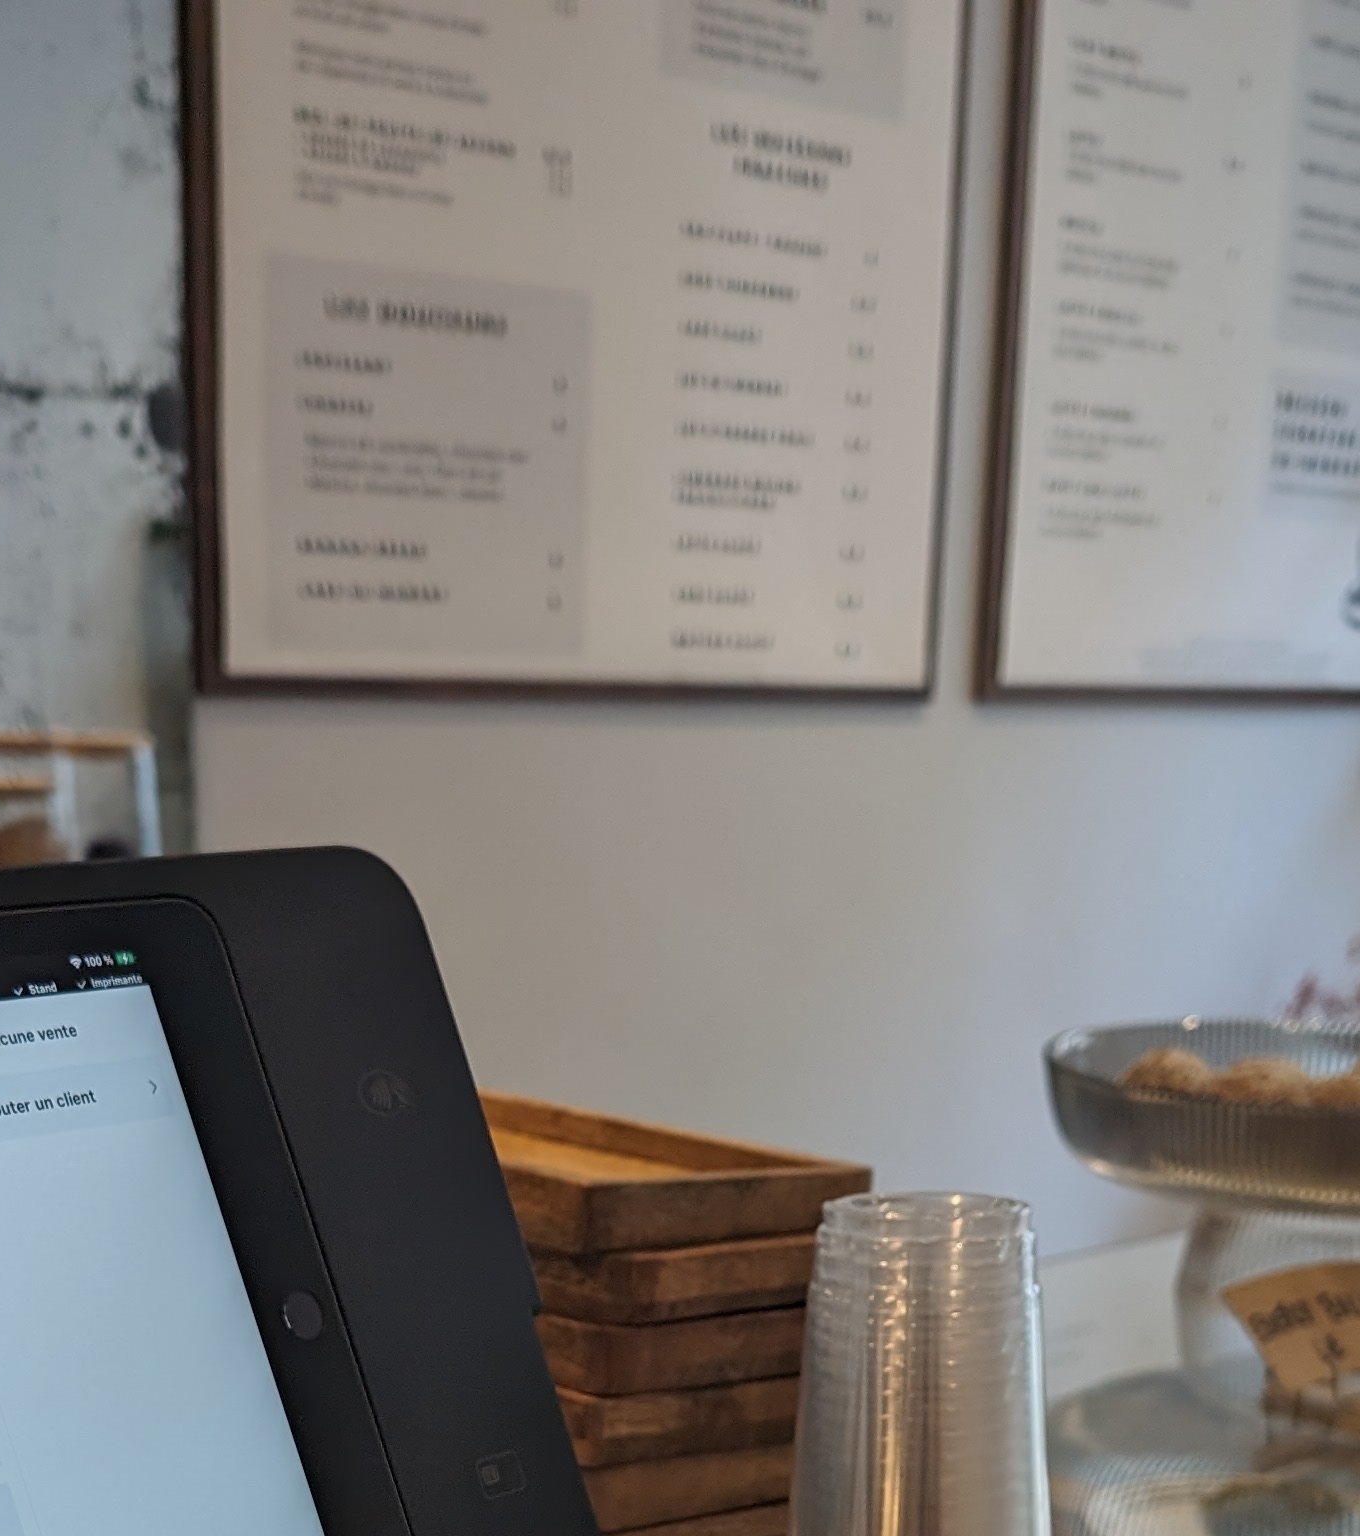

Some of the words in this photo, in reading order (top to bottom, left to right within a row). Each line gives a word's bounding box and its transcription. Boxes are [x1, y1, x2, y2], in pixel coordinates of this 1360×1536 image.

[84, 954, 103, 967] 100
[103, 954, 114, 966] %
[29, 982, 58, 995] Stand
[91, 974, 143, 989] Imprimante
[37, 1024, 78, 1041] vente
[34, 1097, 55, 1111] un
[56, 1089, 97, 1108] client
